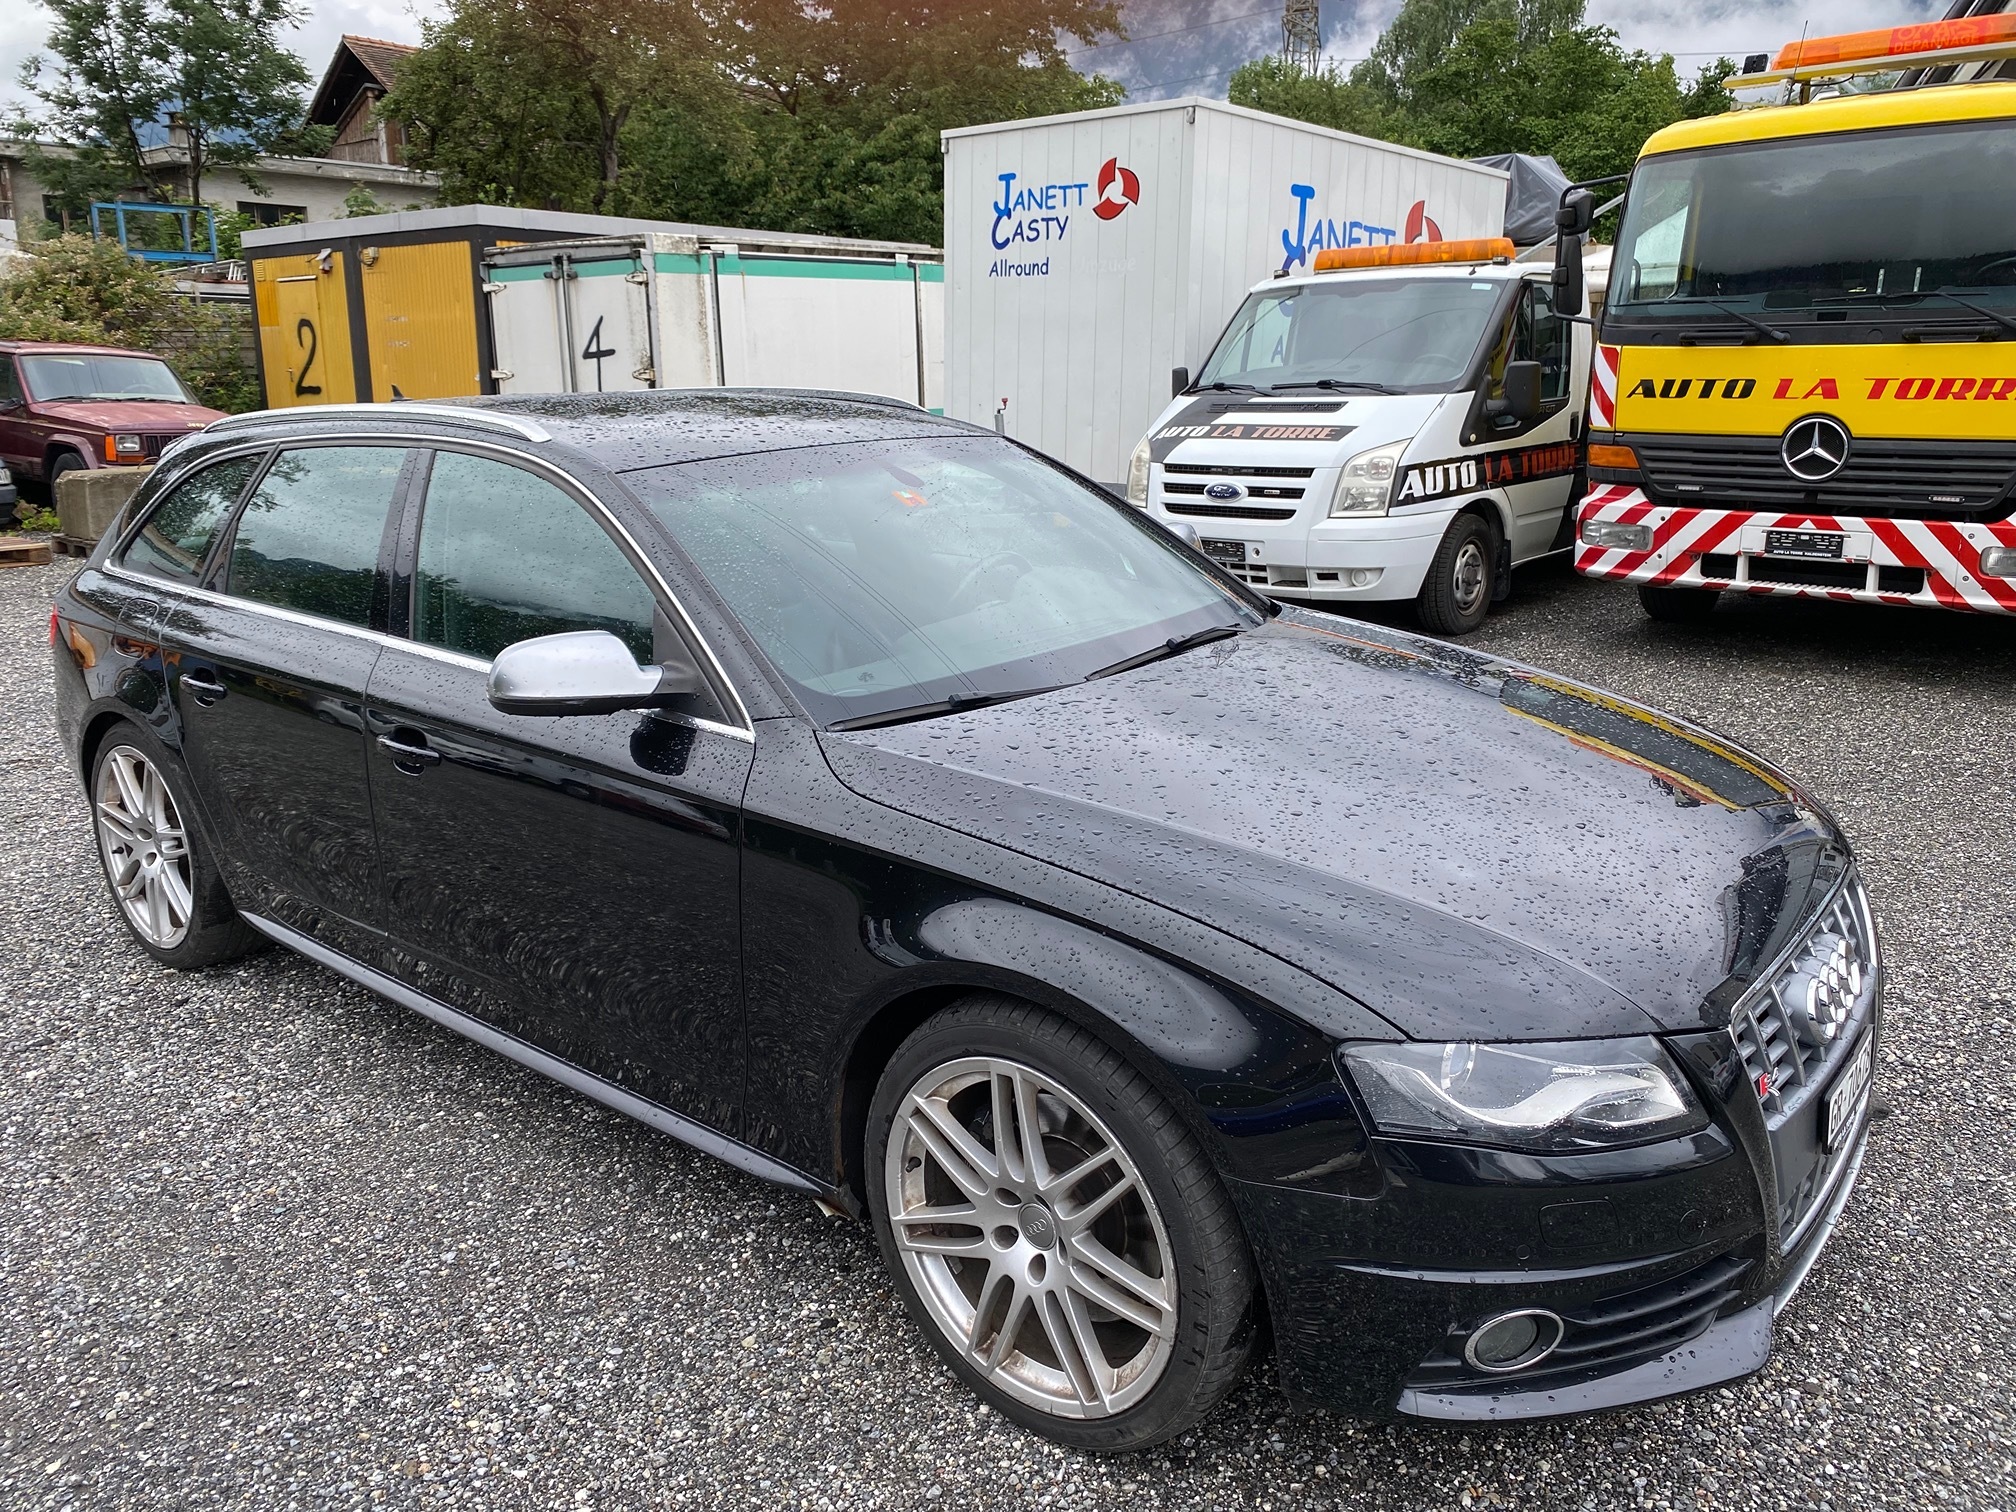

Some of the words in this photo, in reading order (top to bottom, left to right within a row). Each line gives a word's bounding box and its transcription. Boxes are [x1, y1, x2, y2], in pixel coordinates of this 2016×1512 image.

[993, 173, 1088, 216] JANETT
[991, 207, 1069, 251] CASTY
[1282, 184, 1396, 259] JANETT
[989, 257, 1049, 278] Allround
[295, 318, 322, 398] 2
[582, 314, 616, 392] 4
[1626, 378, 1757, 399] AUTO
[1772, 378, 1840, 399] LA
[1864, 377, 2016, 400] TORR
[1152, 425, 1211, 441] AUTO
[1211, 425, 1244, 438] LA
[1251, 426, 1340, 438] TORRE
[1398, 460, 1477, 500] AUTO
[1485, 454, 1513, 484] LA
[1519, 444, 1580, 478] TORRE
